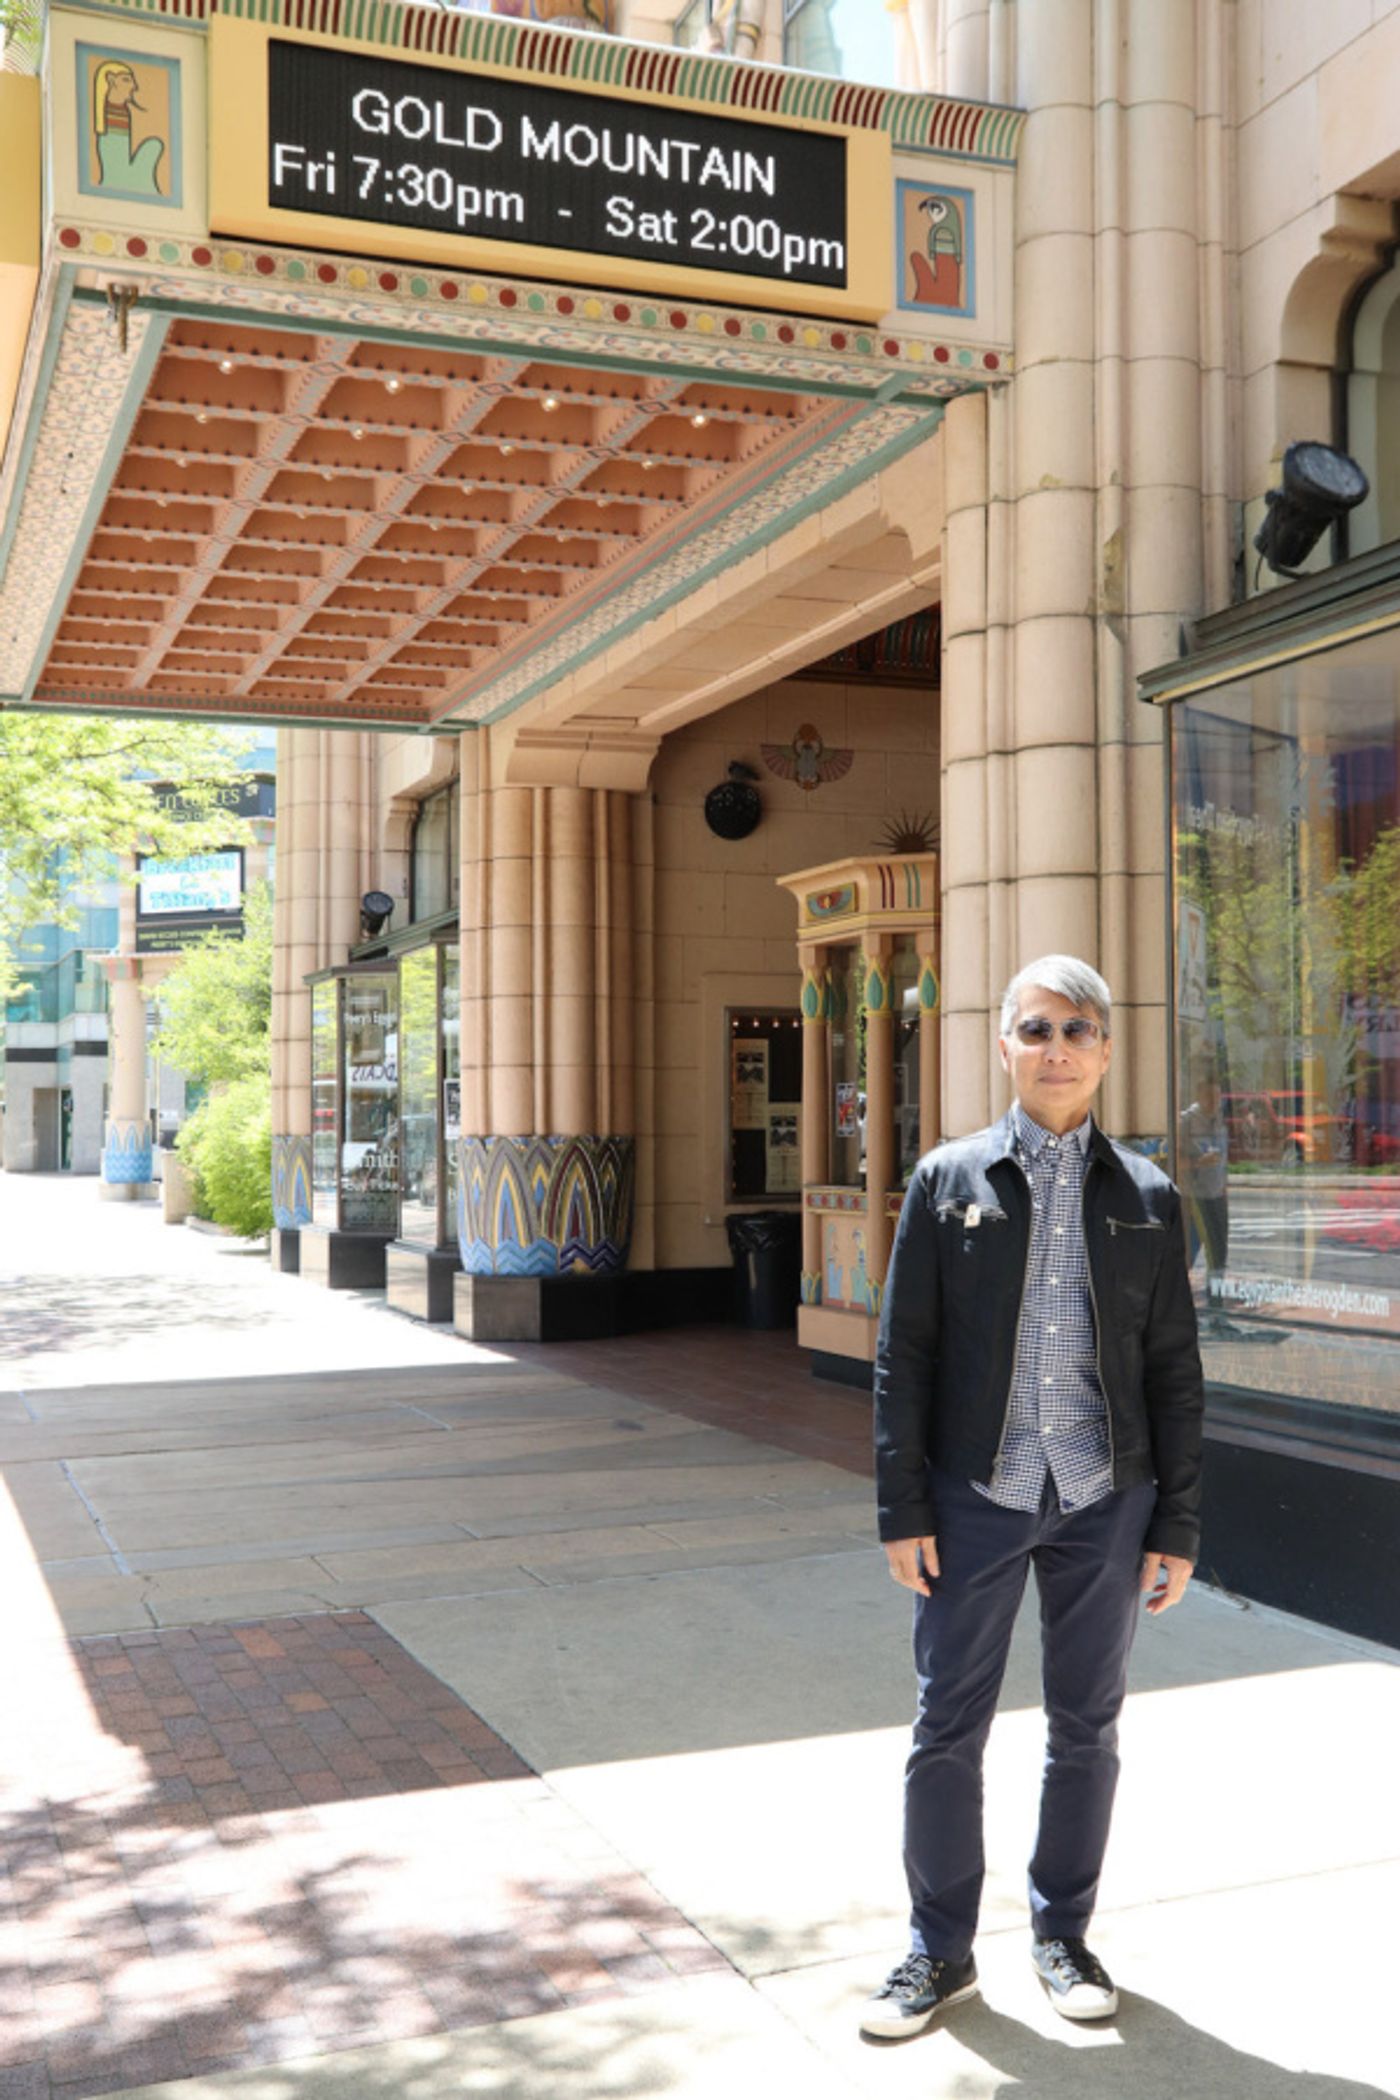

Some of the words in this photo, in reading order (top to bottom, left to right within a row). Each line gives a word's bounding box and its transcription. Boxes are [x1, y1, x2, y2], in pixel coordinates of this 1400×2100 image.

[352, 88, 503, 152] GOLD
[521, 115, 776, 197] MOUNTAIN
[274, 142, 337, 195] Fri
[352, 155, 525, 227] 7:30pm
[605, 195, 679, 245] Sat
[690, 208, 845, 274] 2:00pm
